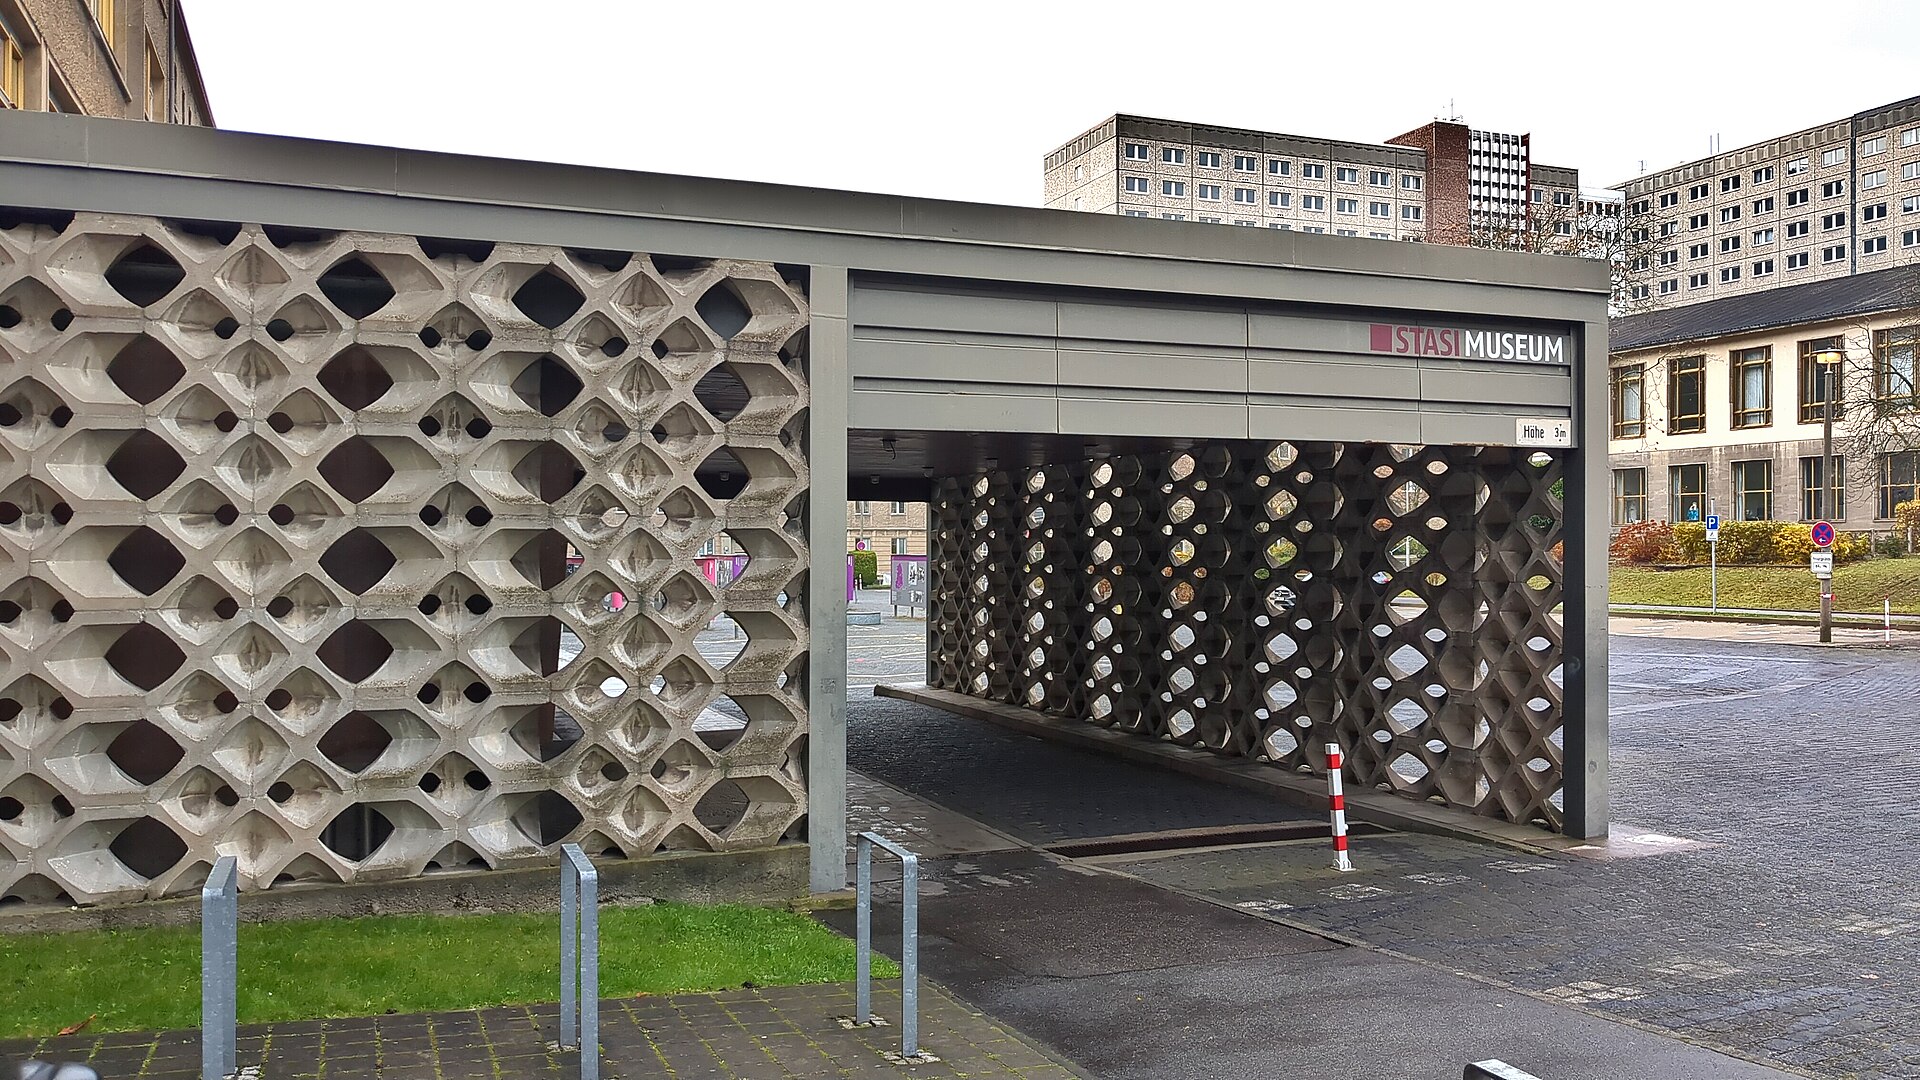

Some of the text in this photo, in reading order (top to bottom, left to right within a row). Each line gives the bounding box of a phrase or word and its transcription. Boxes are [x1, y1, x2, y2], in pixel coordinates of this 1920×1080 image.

[1396, 326, 1564, 363] STASI MUSEUM
[1523, 425, 1545, 439] Höhe
[1708, 517, 1716, 529] P
